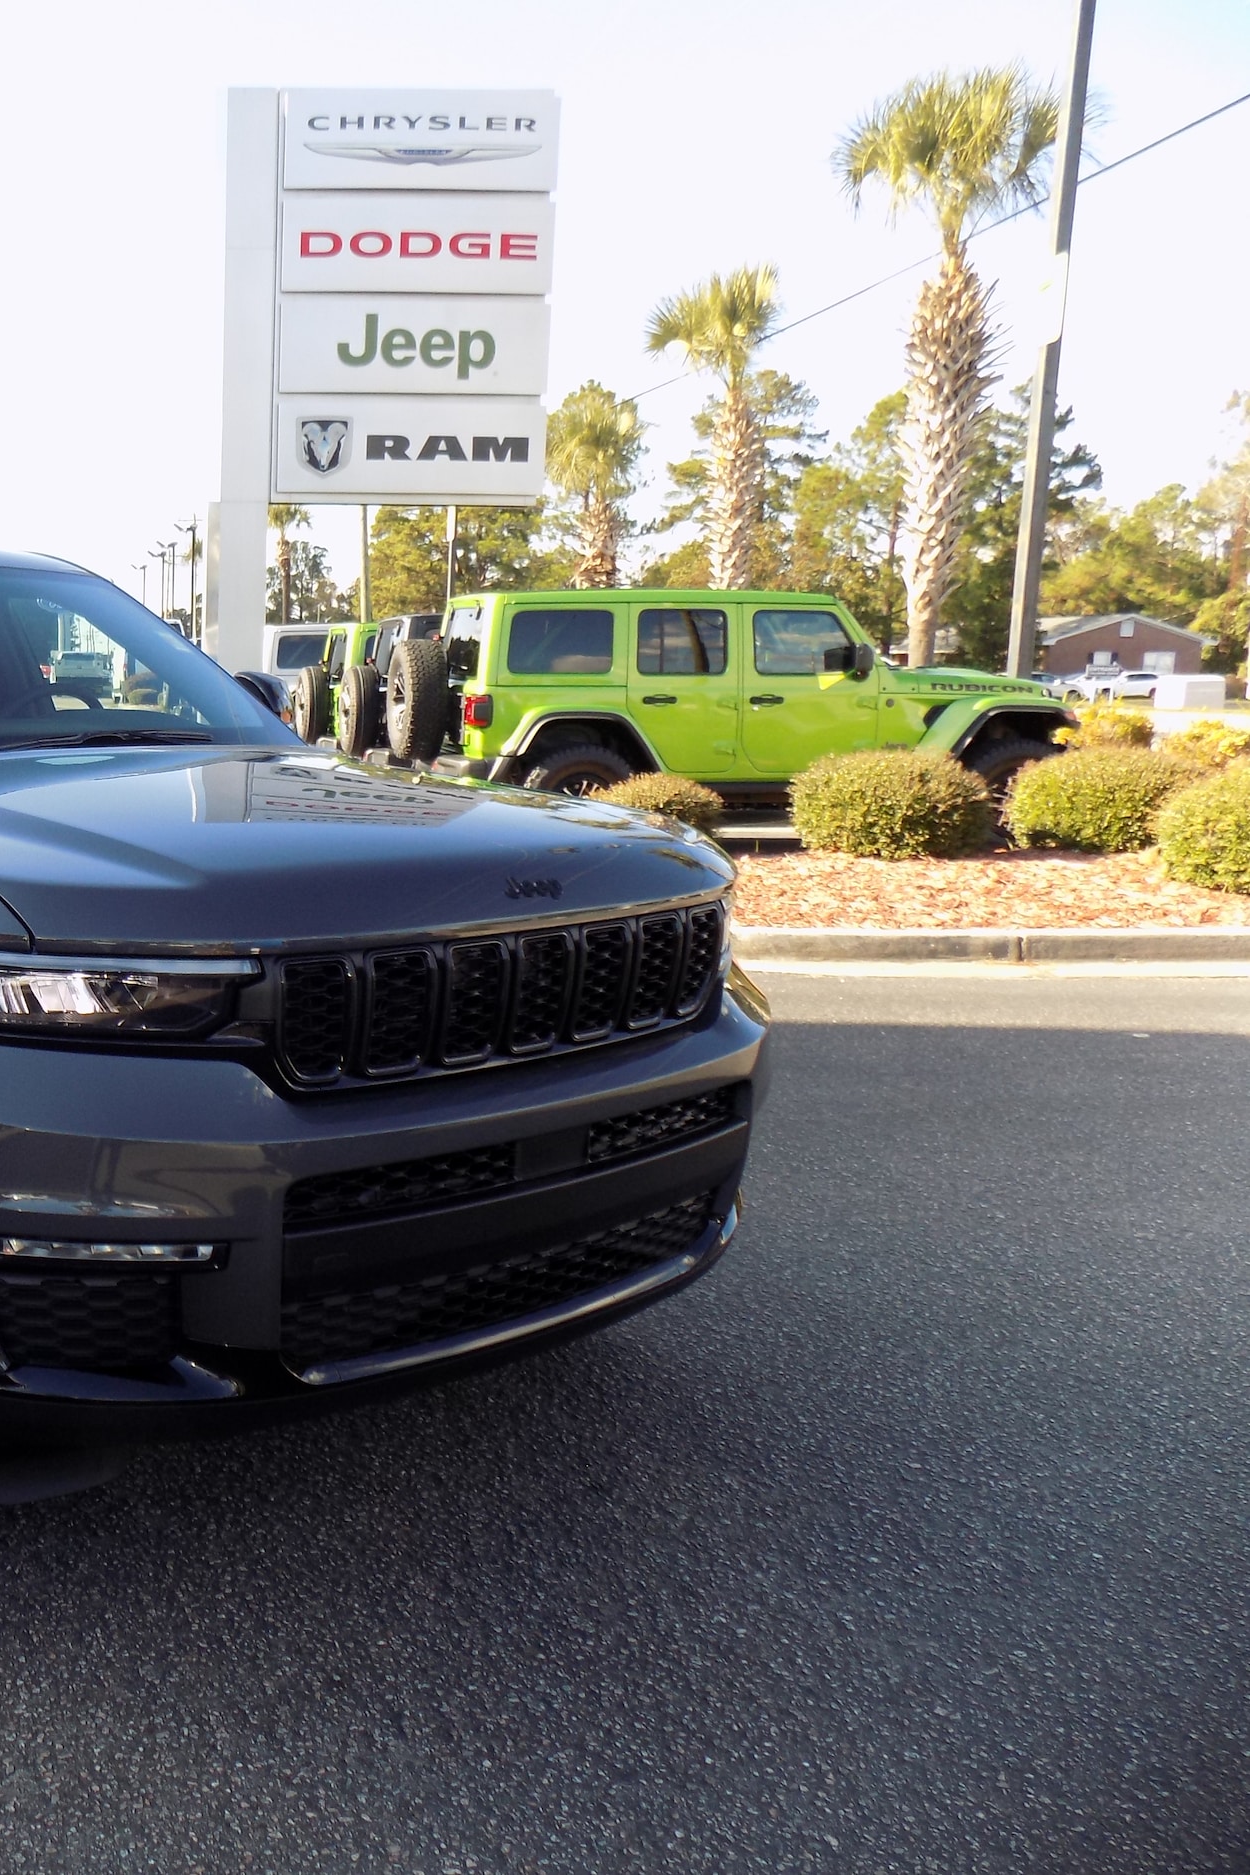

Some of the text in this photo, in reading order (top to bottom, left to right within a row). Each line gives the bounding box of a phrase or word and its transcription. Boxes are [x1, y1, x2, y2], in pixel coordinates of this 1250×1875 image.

[307, 115, 537, 132] CHRYSLER
[300, 231, 538, 260] DODGE
[337, 313, 496, 380] Jeep
[366, 435, 529, 462] RAM
[931, 683, 1033, 693] RUBICON
